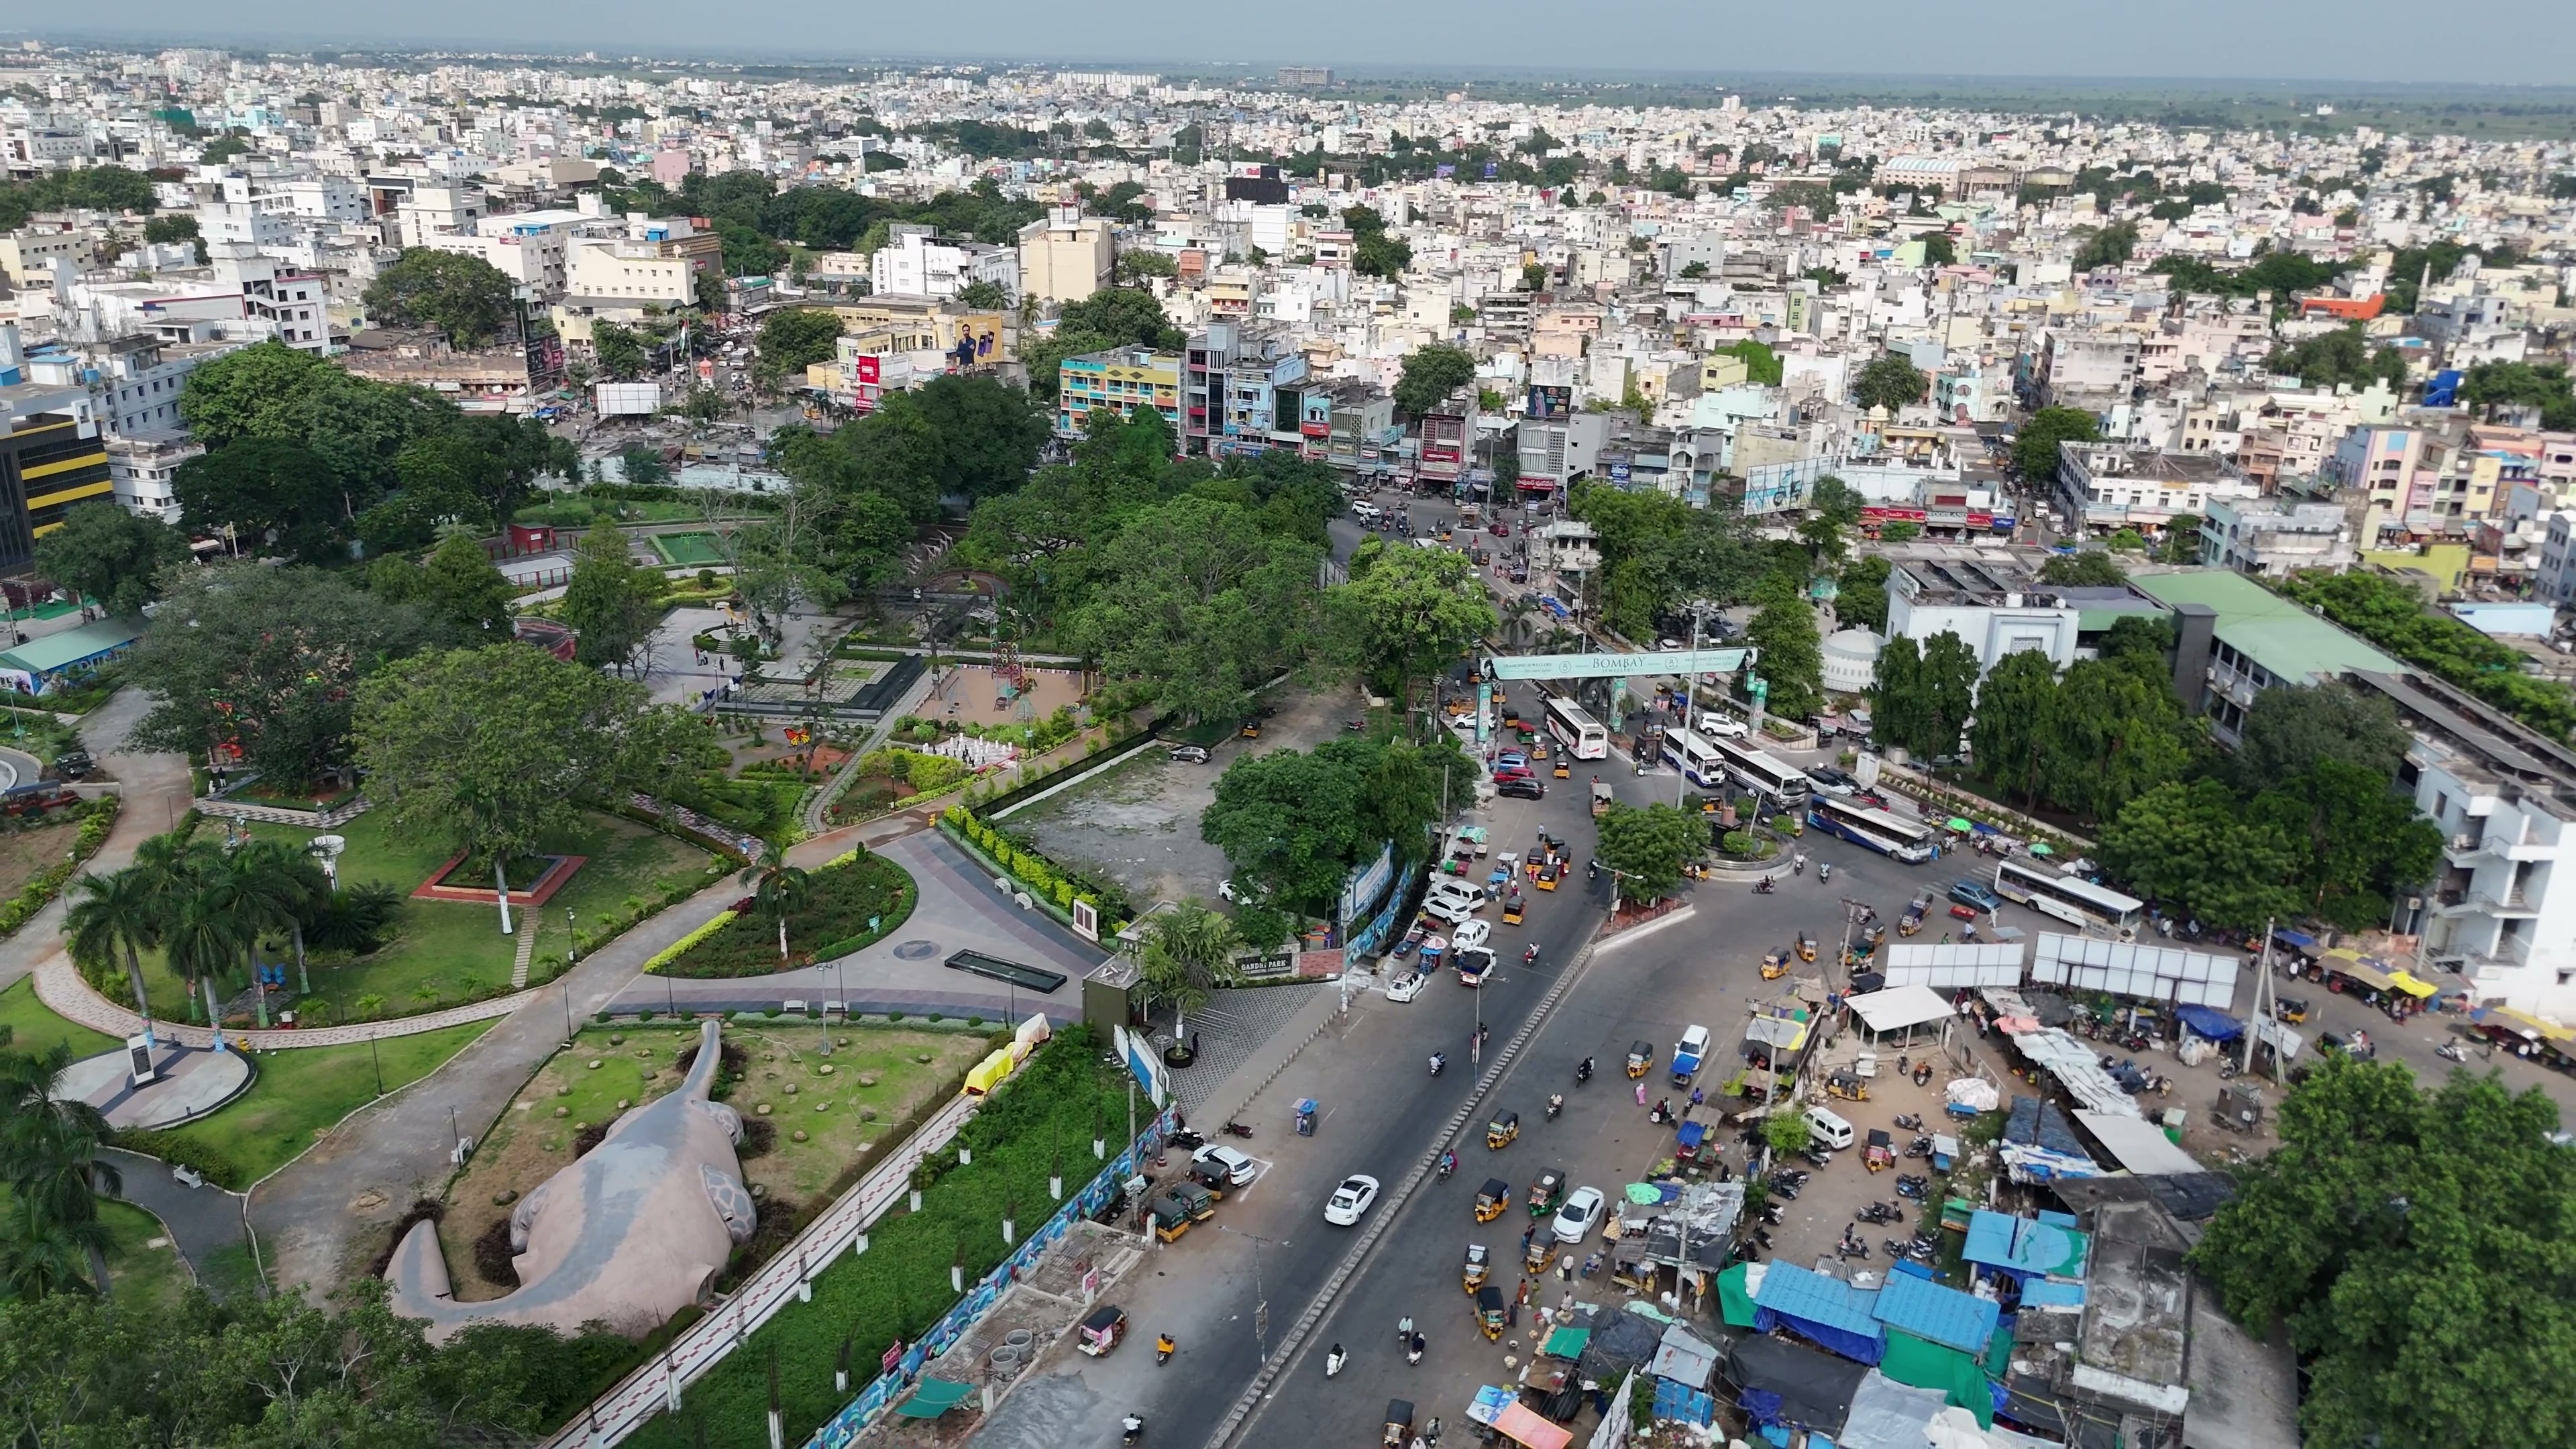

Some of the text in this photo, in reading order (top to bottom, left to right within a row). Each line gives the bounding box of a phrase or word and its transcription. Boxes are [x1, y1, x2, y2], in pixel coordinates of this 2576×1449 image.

[1240, 427, 1256, 435] VIP
[1593, 657, 1646, 669] BOMBAY
[1241, 962, 1267, 970] GANDHI
